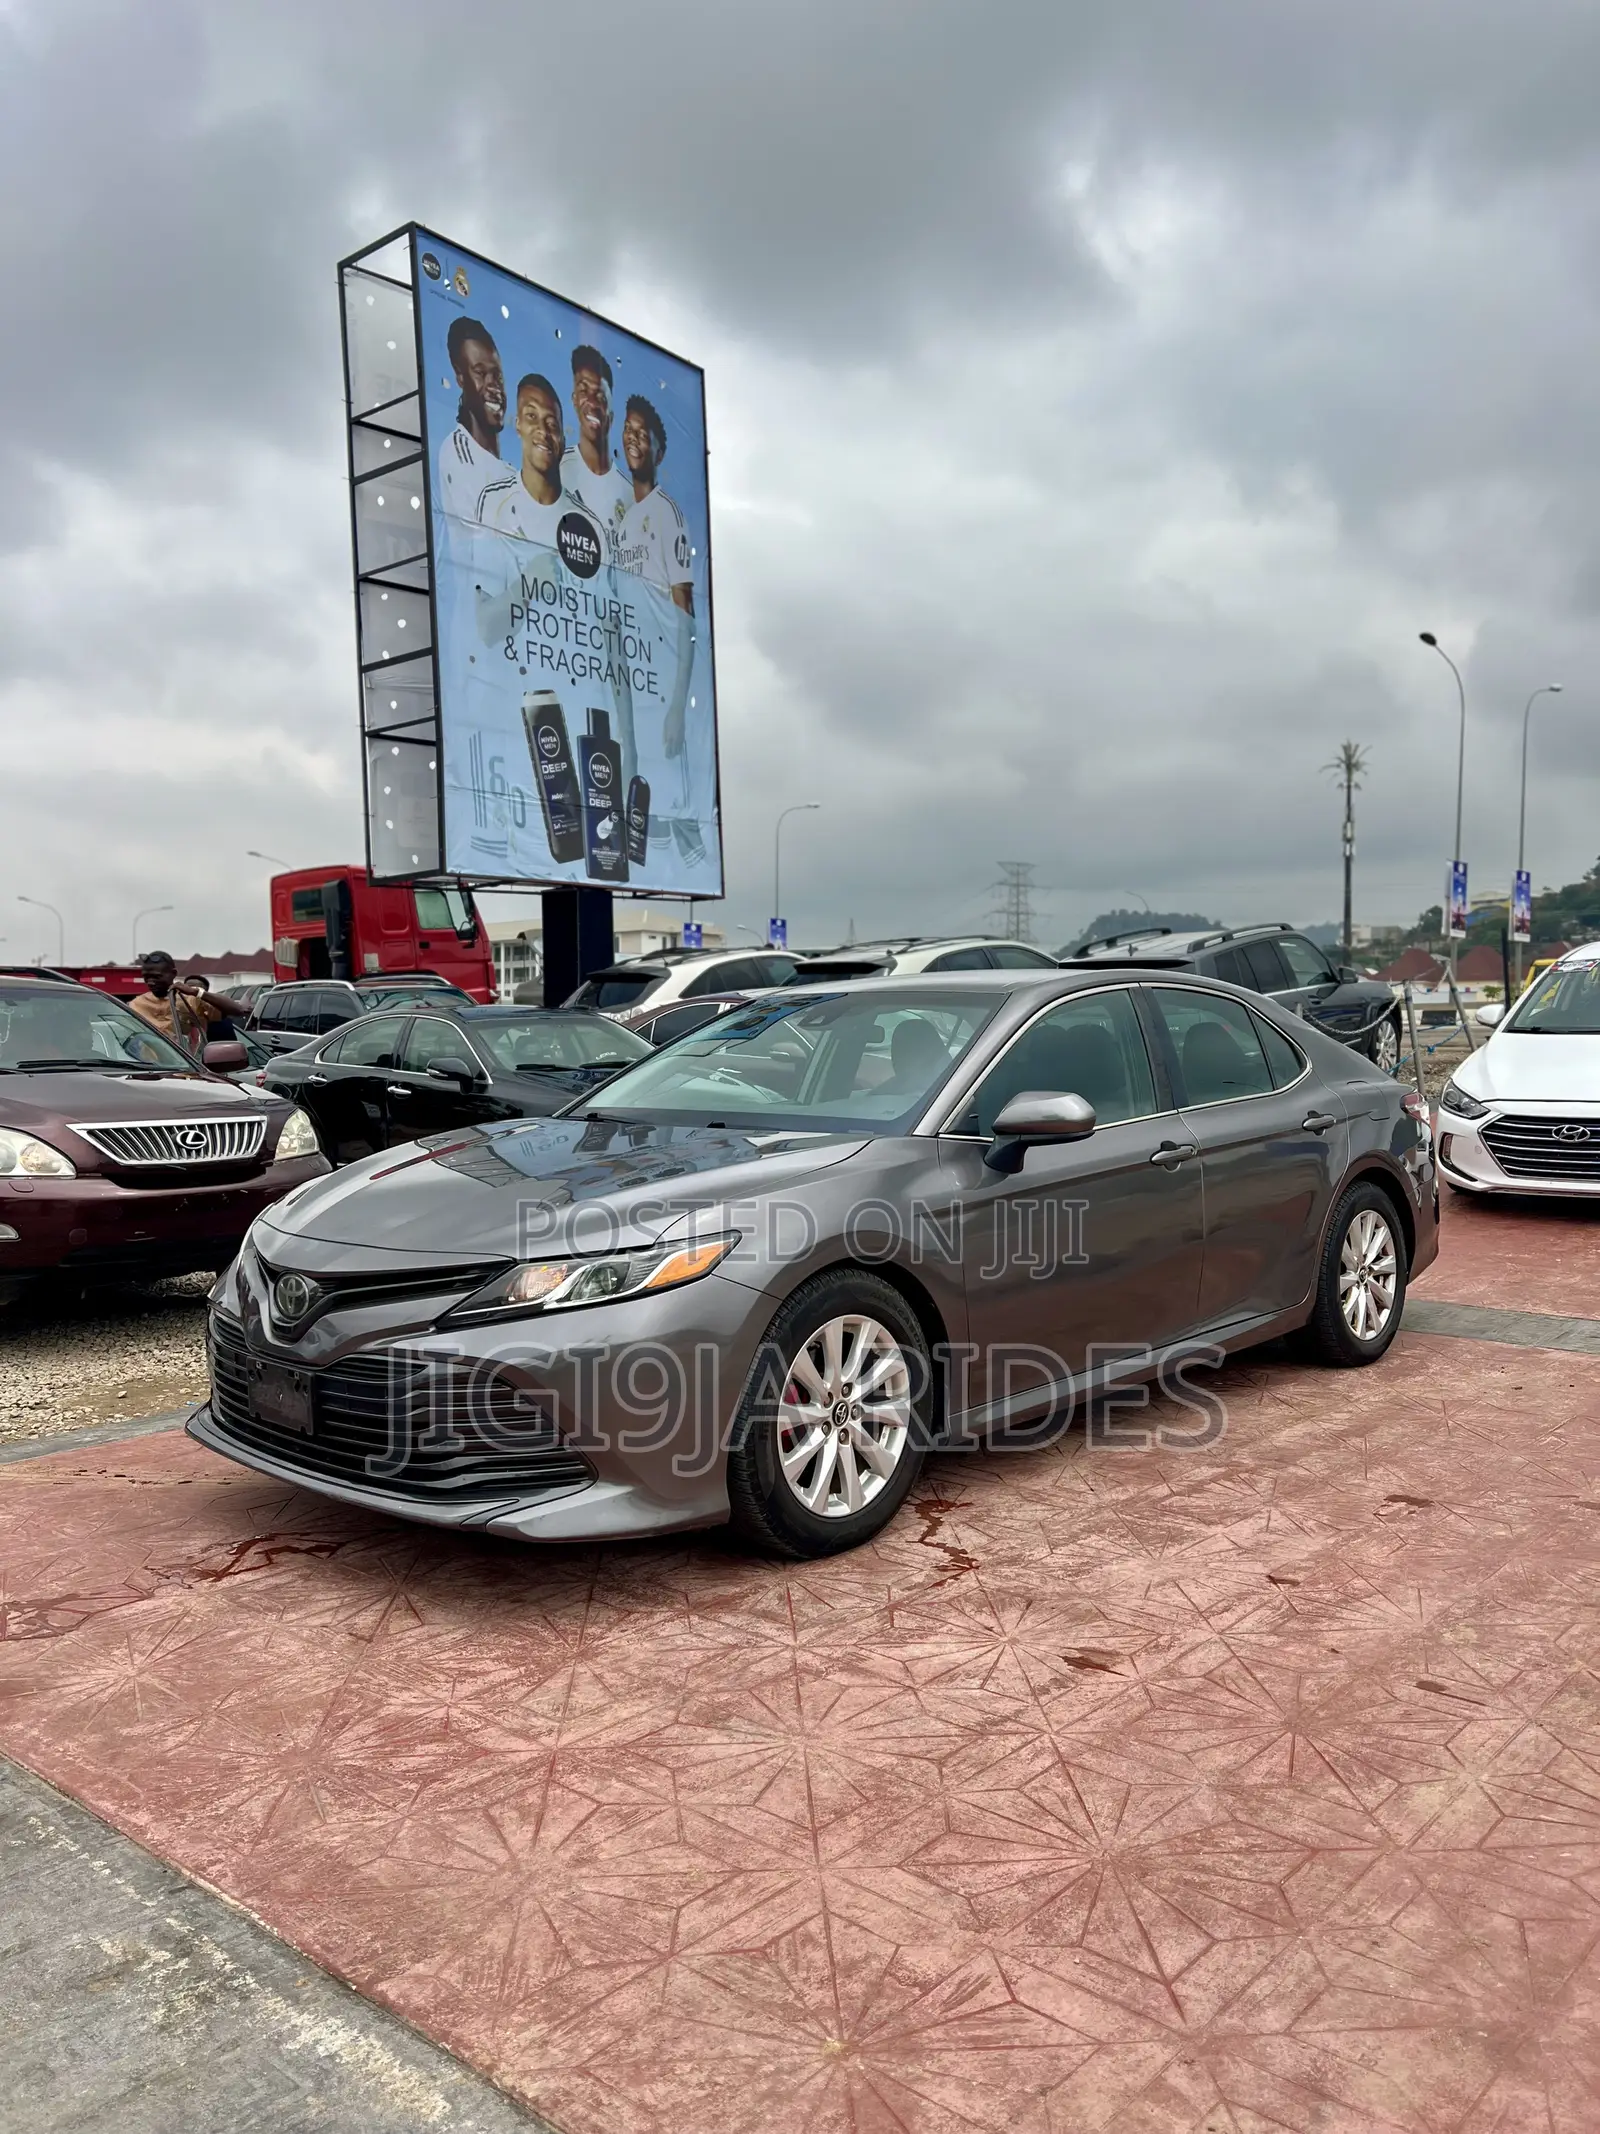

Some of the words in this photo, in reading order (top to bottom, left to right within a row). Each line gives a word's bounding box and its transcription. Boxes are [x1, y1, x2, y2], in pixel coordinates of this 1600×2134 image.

[561, 530, 598, 554] NIVEA
[566, 547, 594, 565] MEN
[521, 573, 641, 635] MOISTURE,
[510, 603, 651, 664] PROTECTION
[504, 635, 519, 662] &
[526, 640, 659, 695] FRAGRANCE
[540, 736, 558, 745] NIVEA
[541, 762, 568, 775] DEEP
[592, 763, 610, 774] NIVEA
[594, 771, 609, 780] MEN
[588, 798, 612, 808] DEEP
